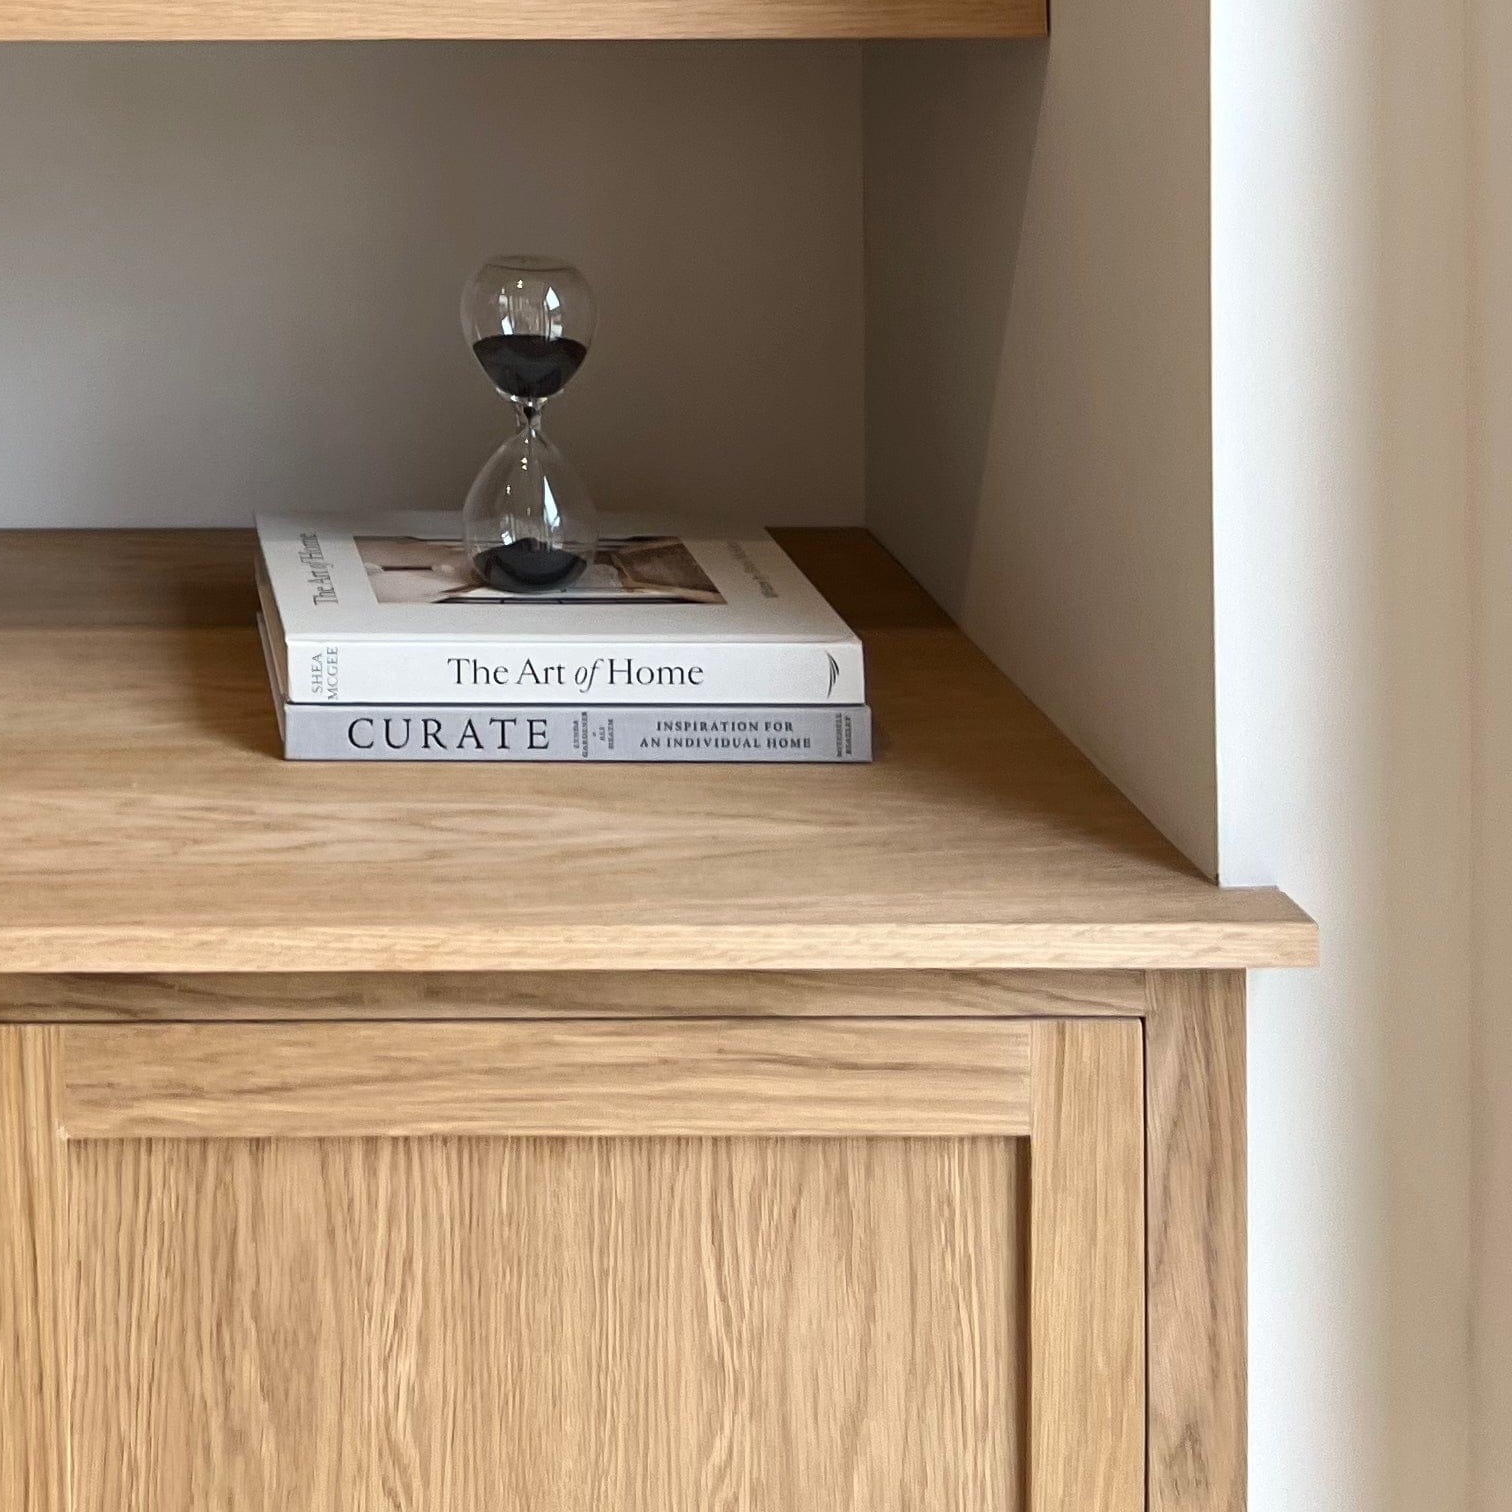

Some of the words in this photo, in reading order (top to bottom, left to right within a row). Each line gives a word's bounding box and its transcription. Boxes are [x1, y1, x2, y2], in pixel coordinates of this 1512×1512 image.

[298, 533, 325, 564] Home
[308, 570, 334, 590] Art
[313, 586, 338, 606] The
[311, 653, 323, 694] SHEA
[447, 658, 509, 685] The
[516, 658, 566, 685] Art
[574, 658, 604, 694] of
[608, 658, 704, 685] Home
[347, 717, 550, 750] CURATE
[656, 721, 759, 732] INSPIRATION
[764, 721, 794, 732] FOR
[639, 737, 661, 748] AN
[666, 737, 762, 748] INDIVIDUAL
[766, 737, 812, 749] HOME
